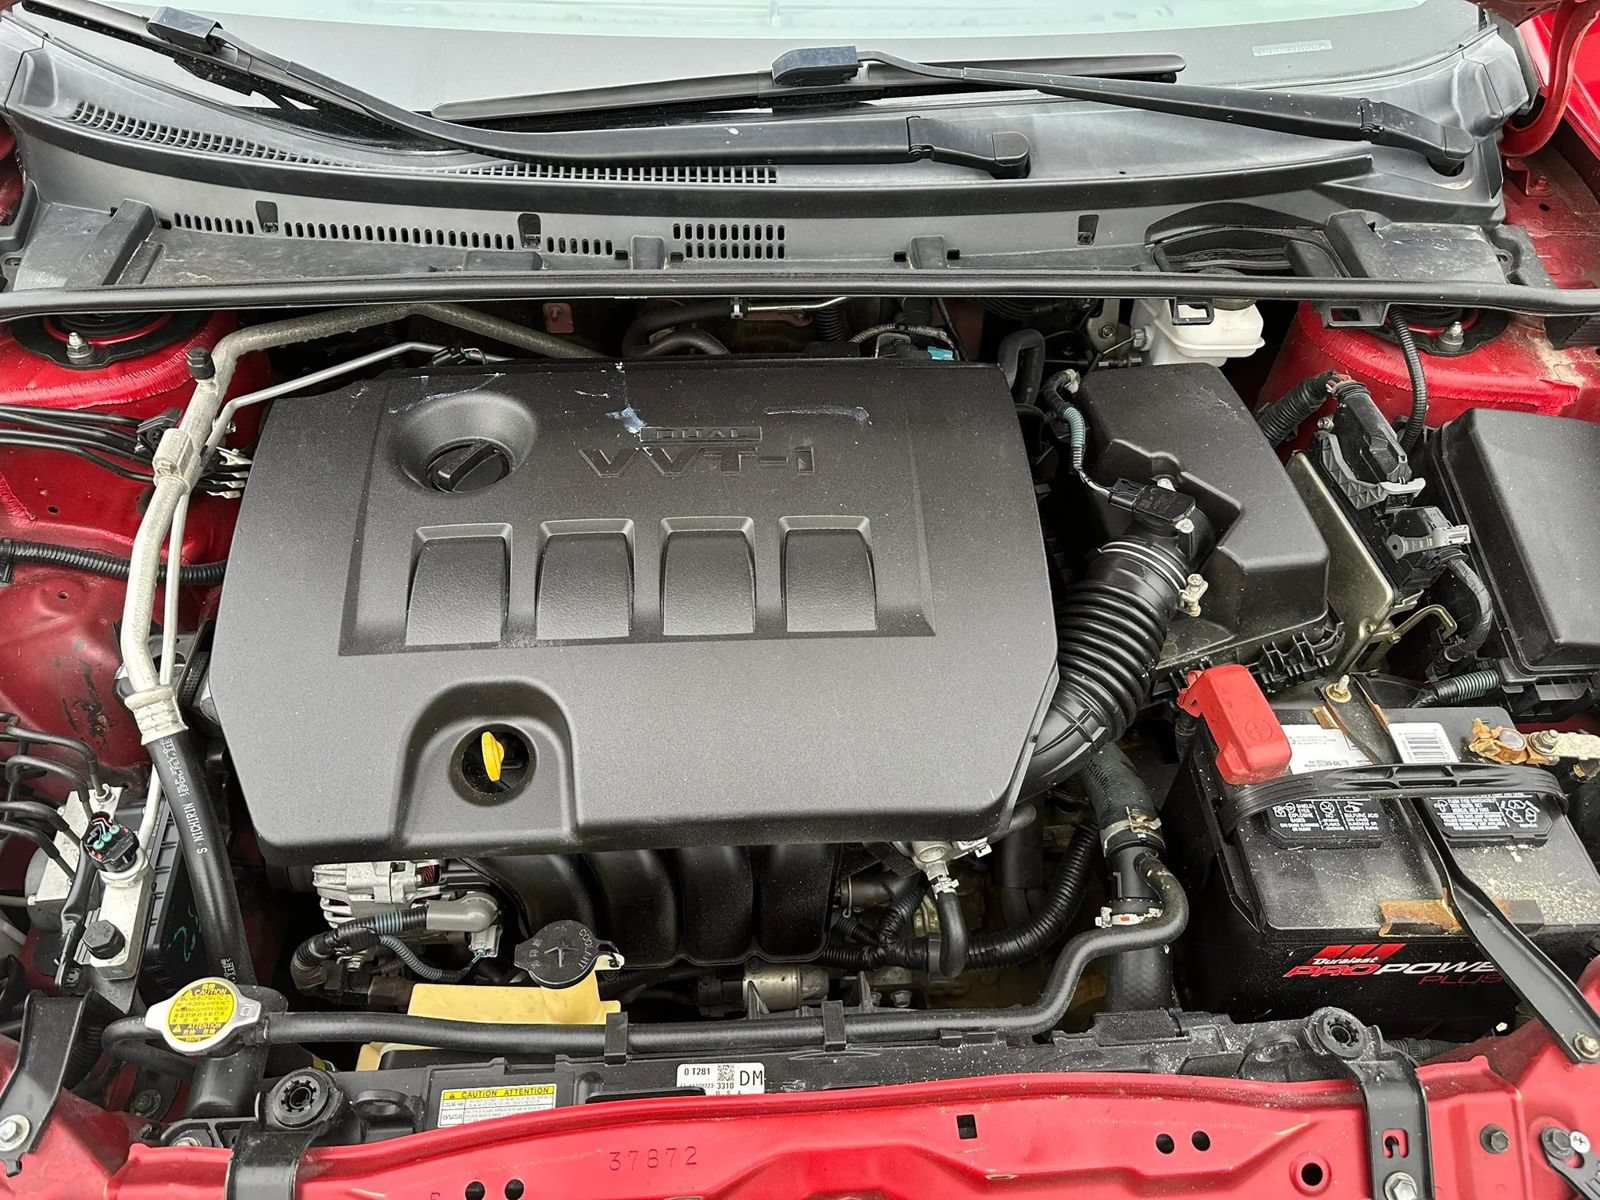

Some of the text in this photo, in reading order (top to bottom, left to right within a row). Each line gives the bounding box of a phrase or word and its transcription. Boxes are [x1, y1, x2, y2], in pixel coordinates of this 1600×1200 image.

[656, 428, 750, 439] DUAL
[1312, 956, 1379, 965] Duralast
[1283, 961, 1498, 978] PROPOWE
[1418, 974, 1505, 985] PLUS
[194, 988, 227, 996] CAUTION
[692, 1067, 711, 1076] T281
[739, 1070, 763, 1086] DM
[716, 1082, 735, 1090] 3310
[461, 1087, 550, 1099] CAUTION ATTENTION
[609, 1146, 698, 1172] 37872
